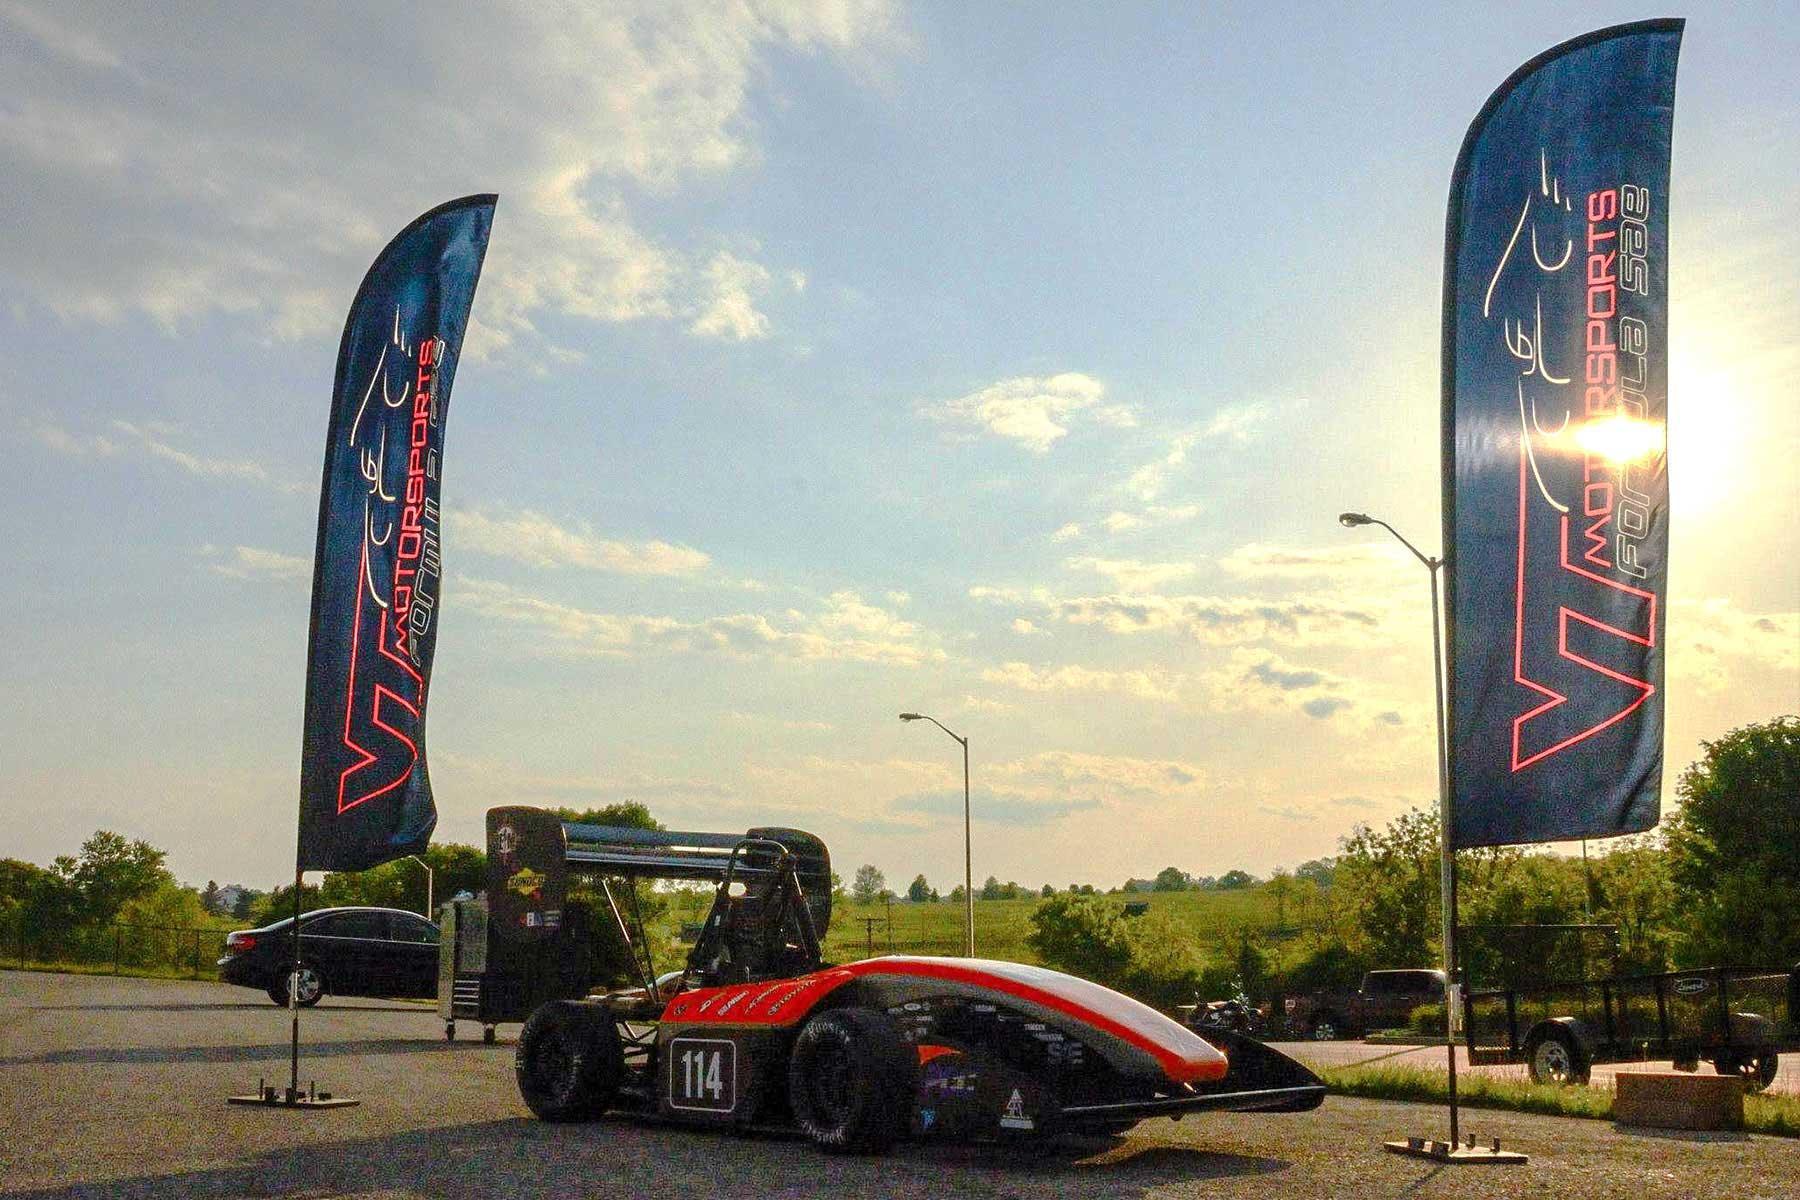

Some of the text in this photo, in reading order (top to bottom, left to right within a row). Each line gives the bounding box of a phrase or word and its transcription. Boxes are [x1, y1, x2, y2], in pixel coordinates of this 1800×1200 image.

[393, 338, 437, 653] MOTORSPORTS
[1584, 187, 1619, 569] MOTRSPORTS
[680, 1050, 723, 1101] 114
